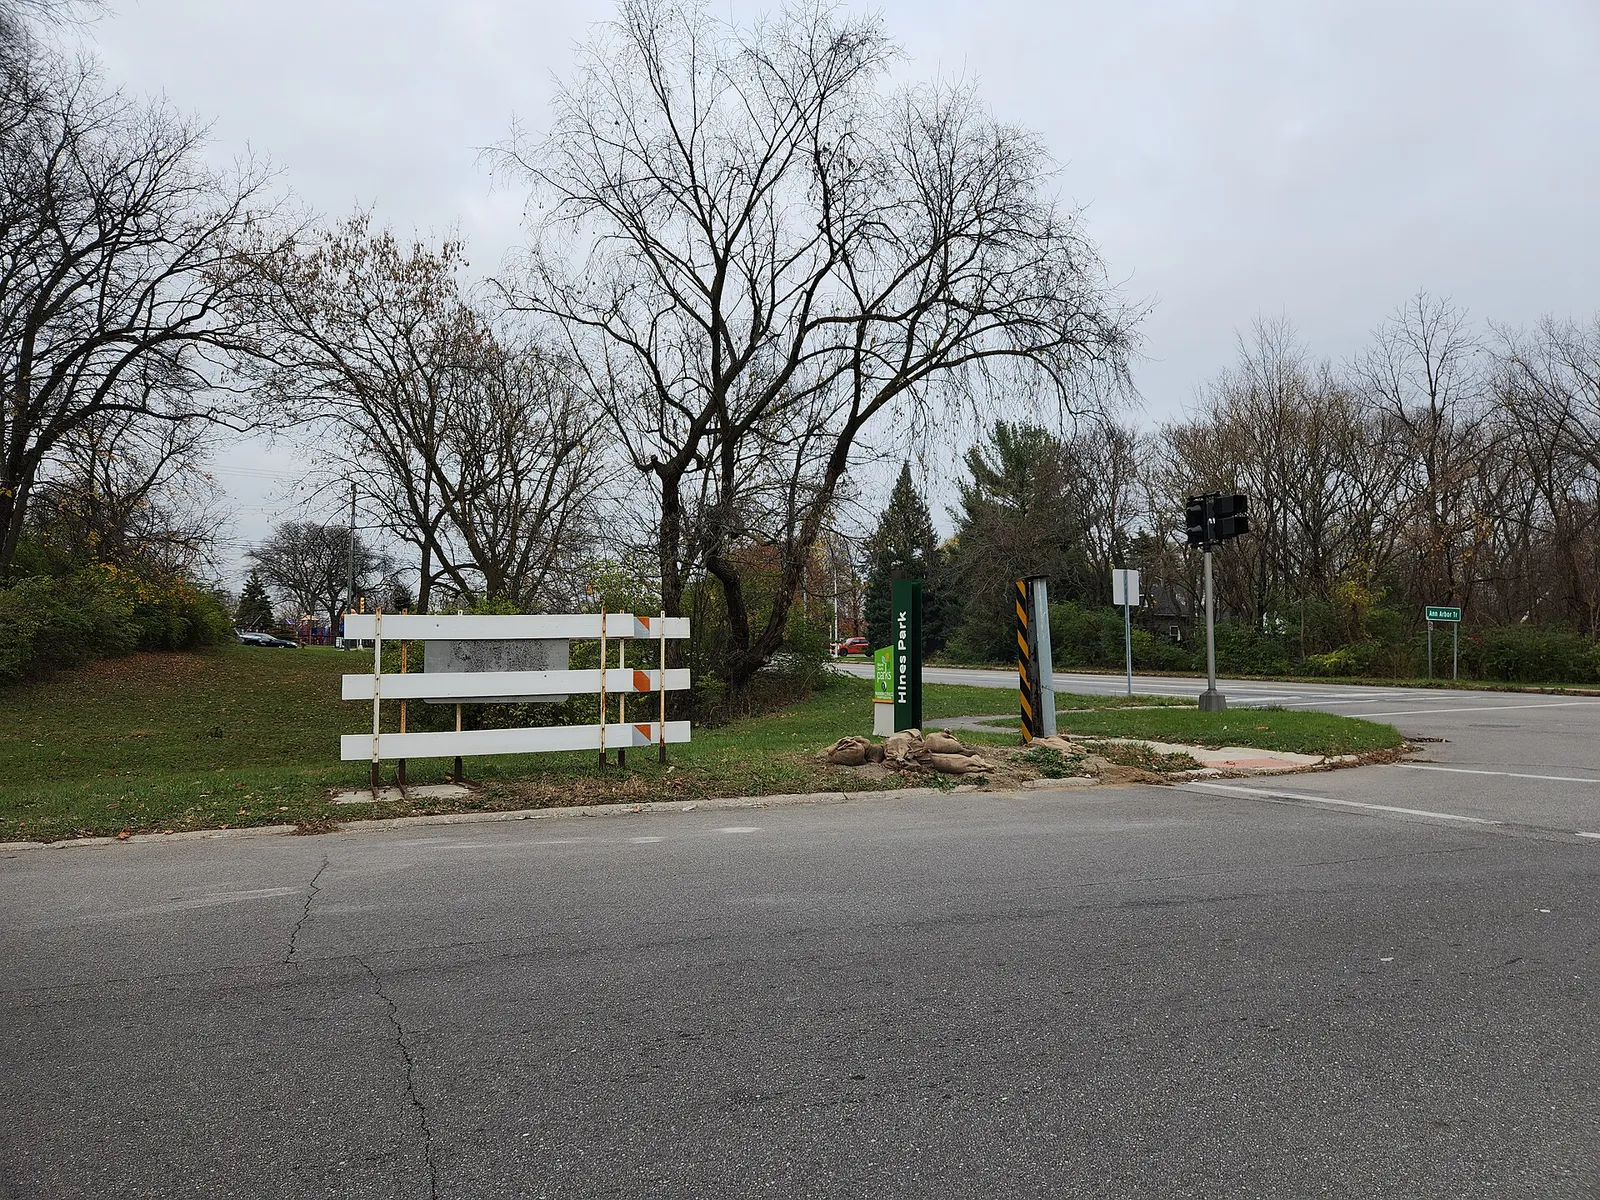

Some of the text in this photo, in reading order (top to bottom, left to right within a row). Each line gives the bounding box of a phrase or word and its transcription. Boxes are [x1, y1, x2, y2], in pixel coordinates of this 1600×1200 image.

[1439, 610, 1452, 618] Arbor
[897, 611, 907, 704] Hines Park
[876, 671, 892, 683] parks
